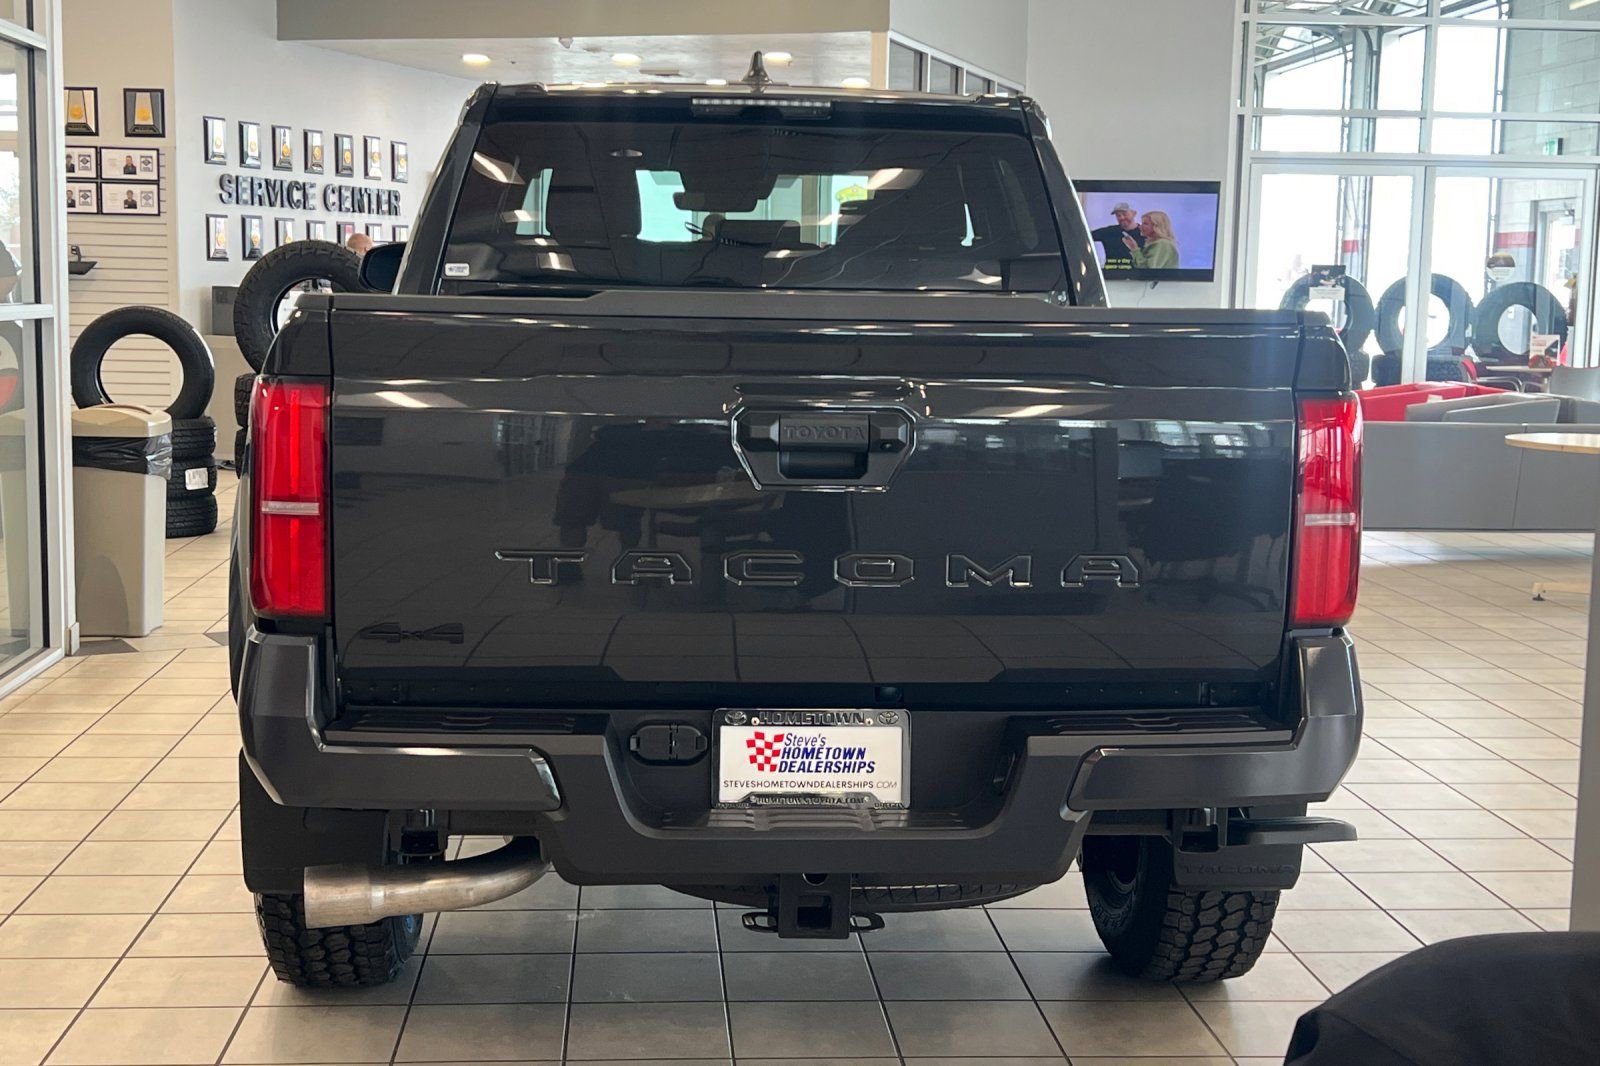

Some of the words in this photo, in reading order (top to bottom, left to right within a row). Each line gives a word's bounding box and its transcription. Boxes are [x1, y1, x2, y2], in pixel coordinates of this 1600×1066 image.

[218, 173, 317, 211] SERVICE
[322, 183, 402, 216] CENTER
[784, 425, 865, 440] TOYOTA
[494, 550, 1141, 588] TACOMA
[759, 711, 865, 725] HOMETOWN
[784, 733, 826, 747] Steve's
[781, 747, 866, 760] HOMETOWN
[778, 761, 876, 773] DEALERSHIPS
